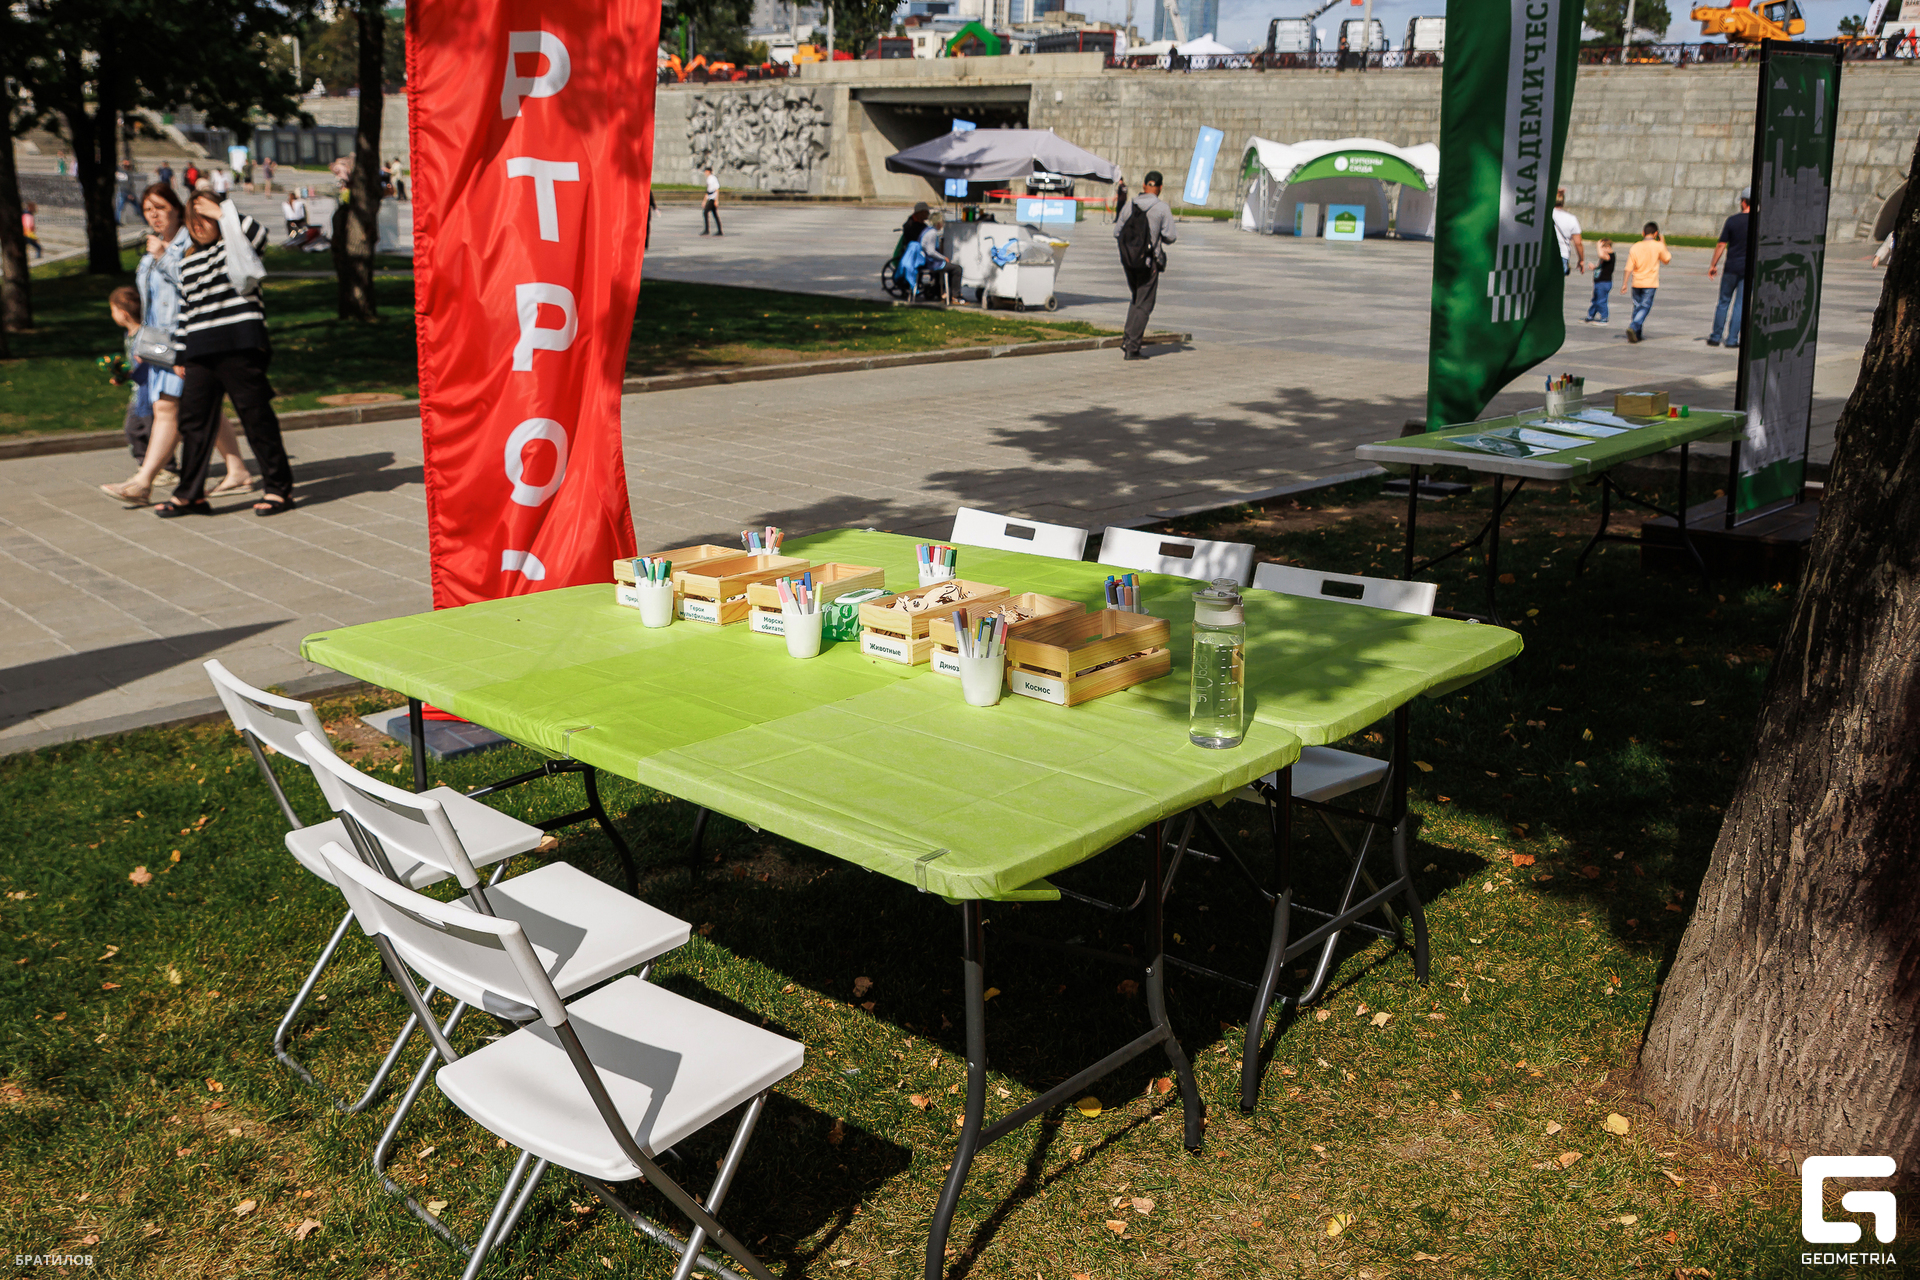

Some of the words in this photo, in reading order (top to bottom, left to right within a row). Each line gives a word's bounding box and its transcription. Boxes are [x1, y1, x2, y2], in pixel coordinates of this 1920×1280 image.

[1514, 0, 1550, 228] АКАДЕМИЧЕС
[1350, 157, 1383, 166] КУПОНЫ
[689, 604, 705, 612] Герои
[679, 610, 716, 622] мультфильмов
[761, 623, 785, 633] обитате
[869, 642, 902, 656] Животные
[1024, 681, 1051, 695] Космос
